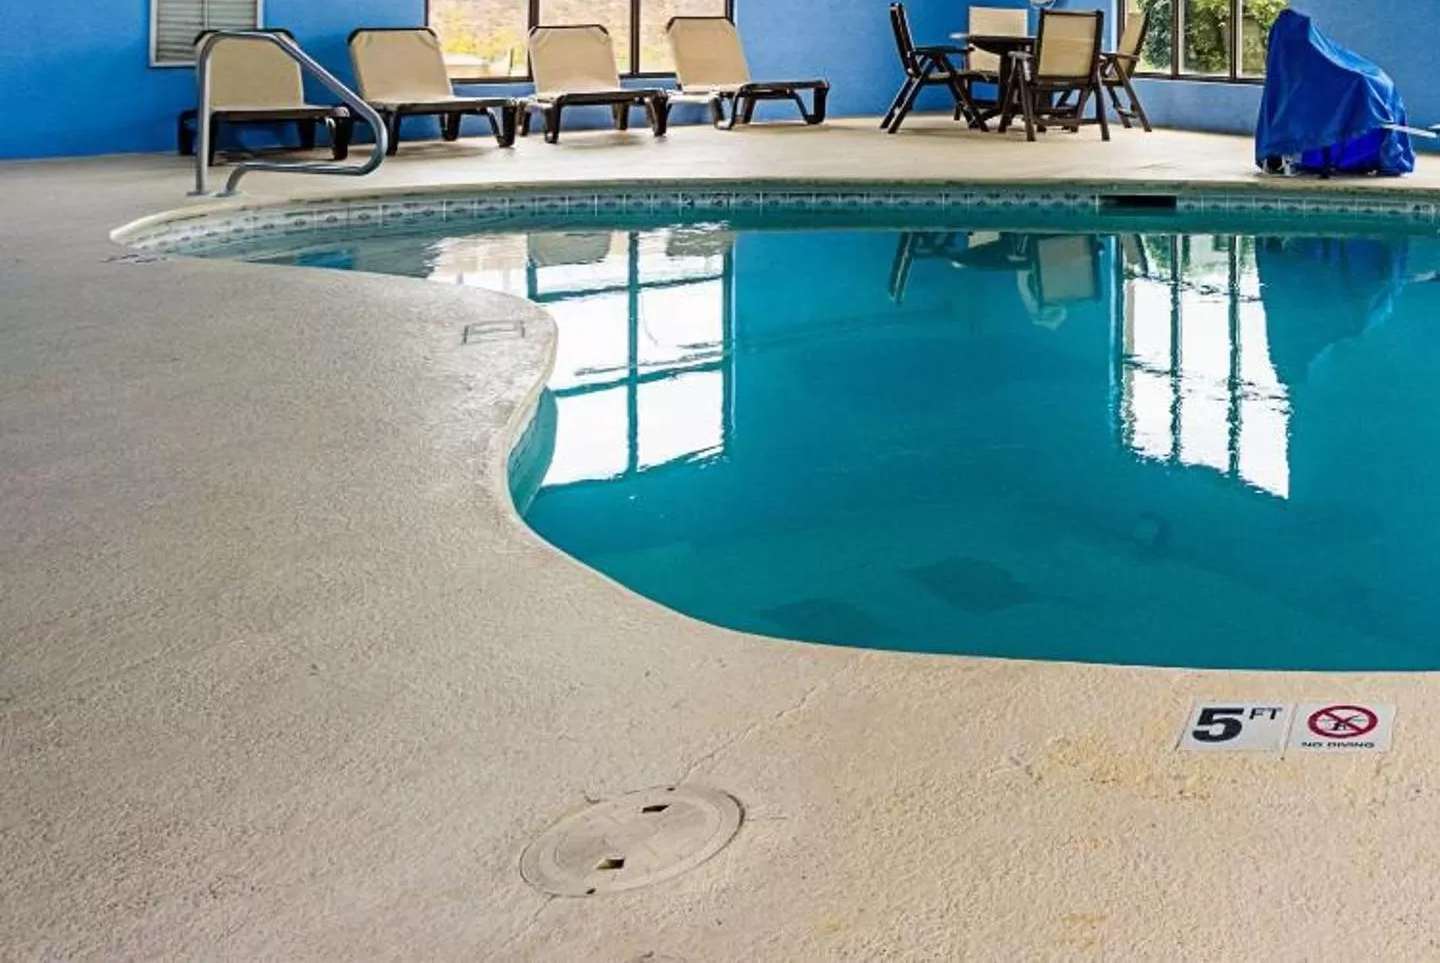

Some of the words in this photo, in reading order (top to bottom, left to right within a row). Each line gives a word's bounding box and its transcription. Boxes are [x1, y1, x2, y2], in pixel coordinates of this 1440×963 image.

[1192, 708, 1244, 742] 5
[1249, 708, 1283, 720] FT
[1327, 741, 1376, 749] DIVING
